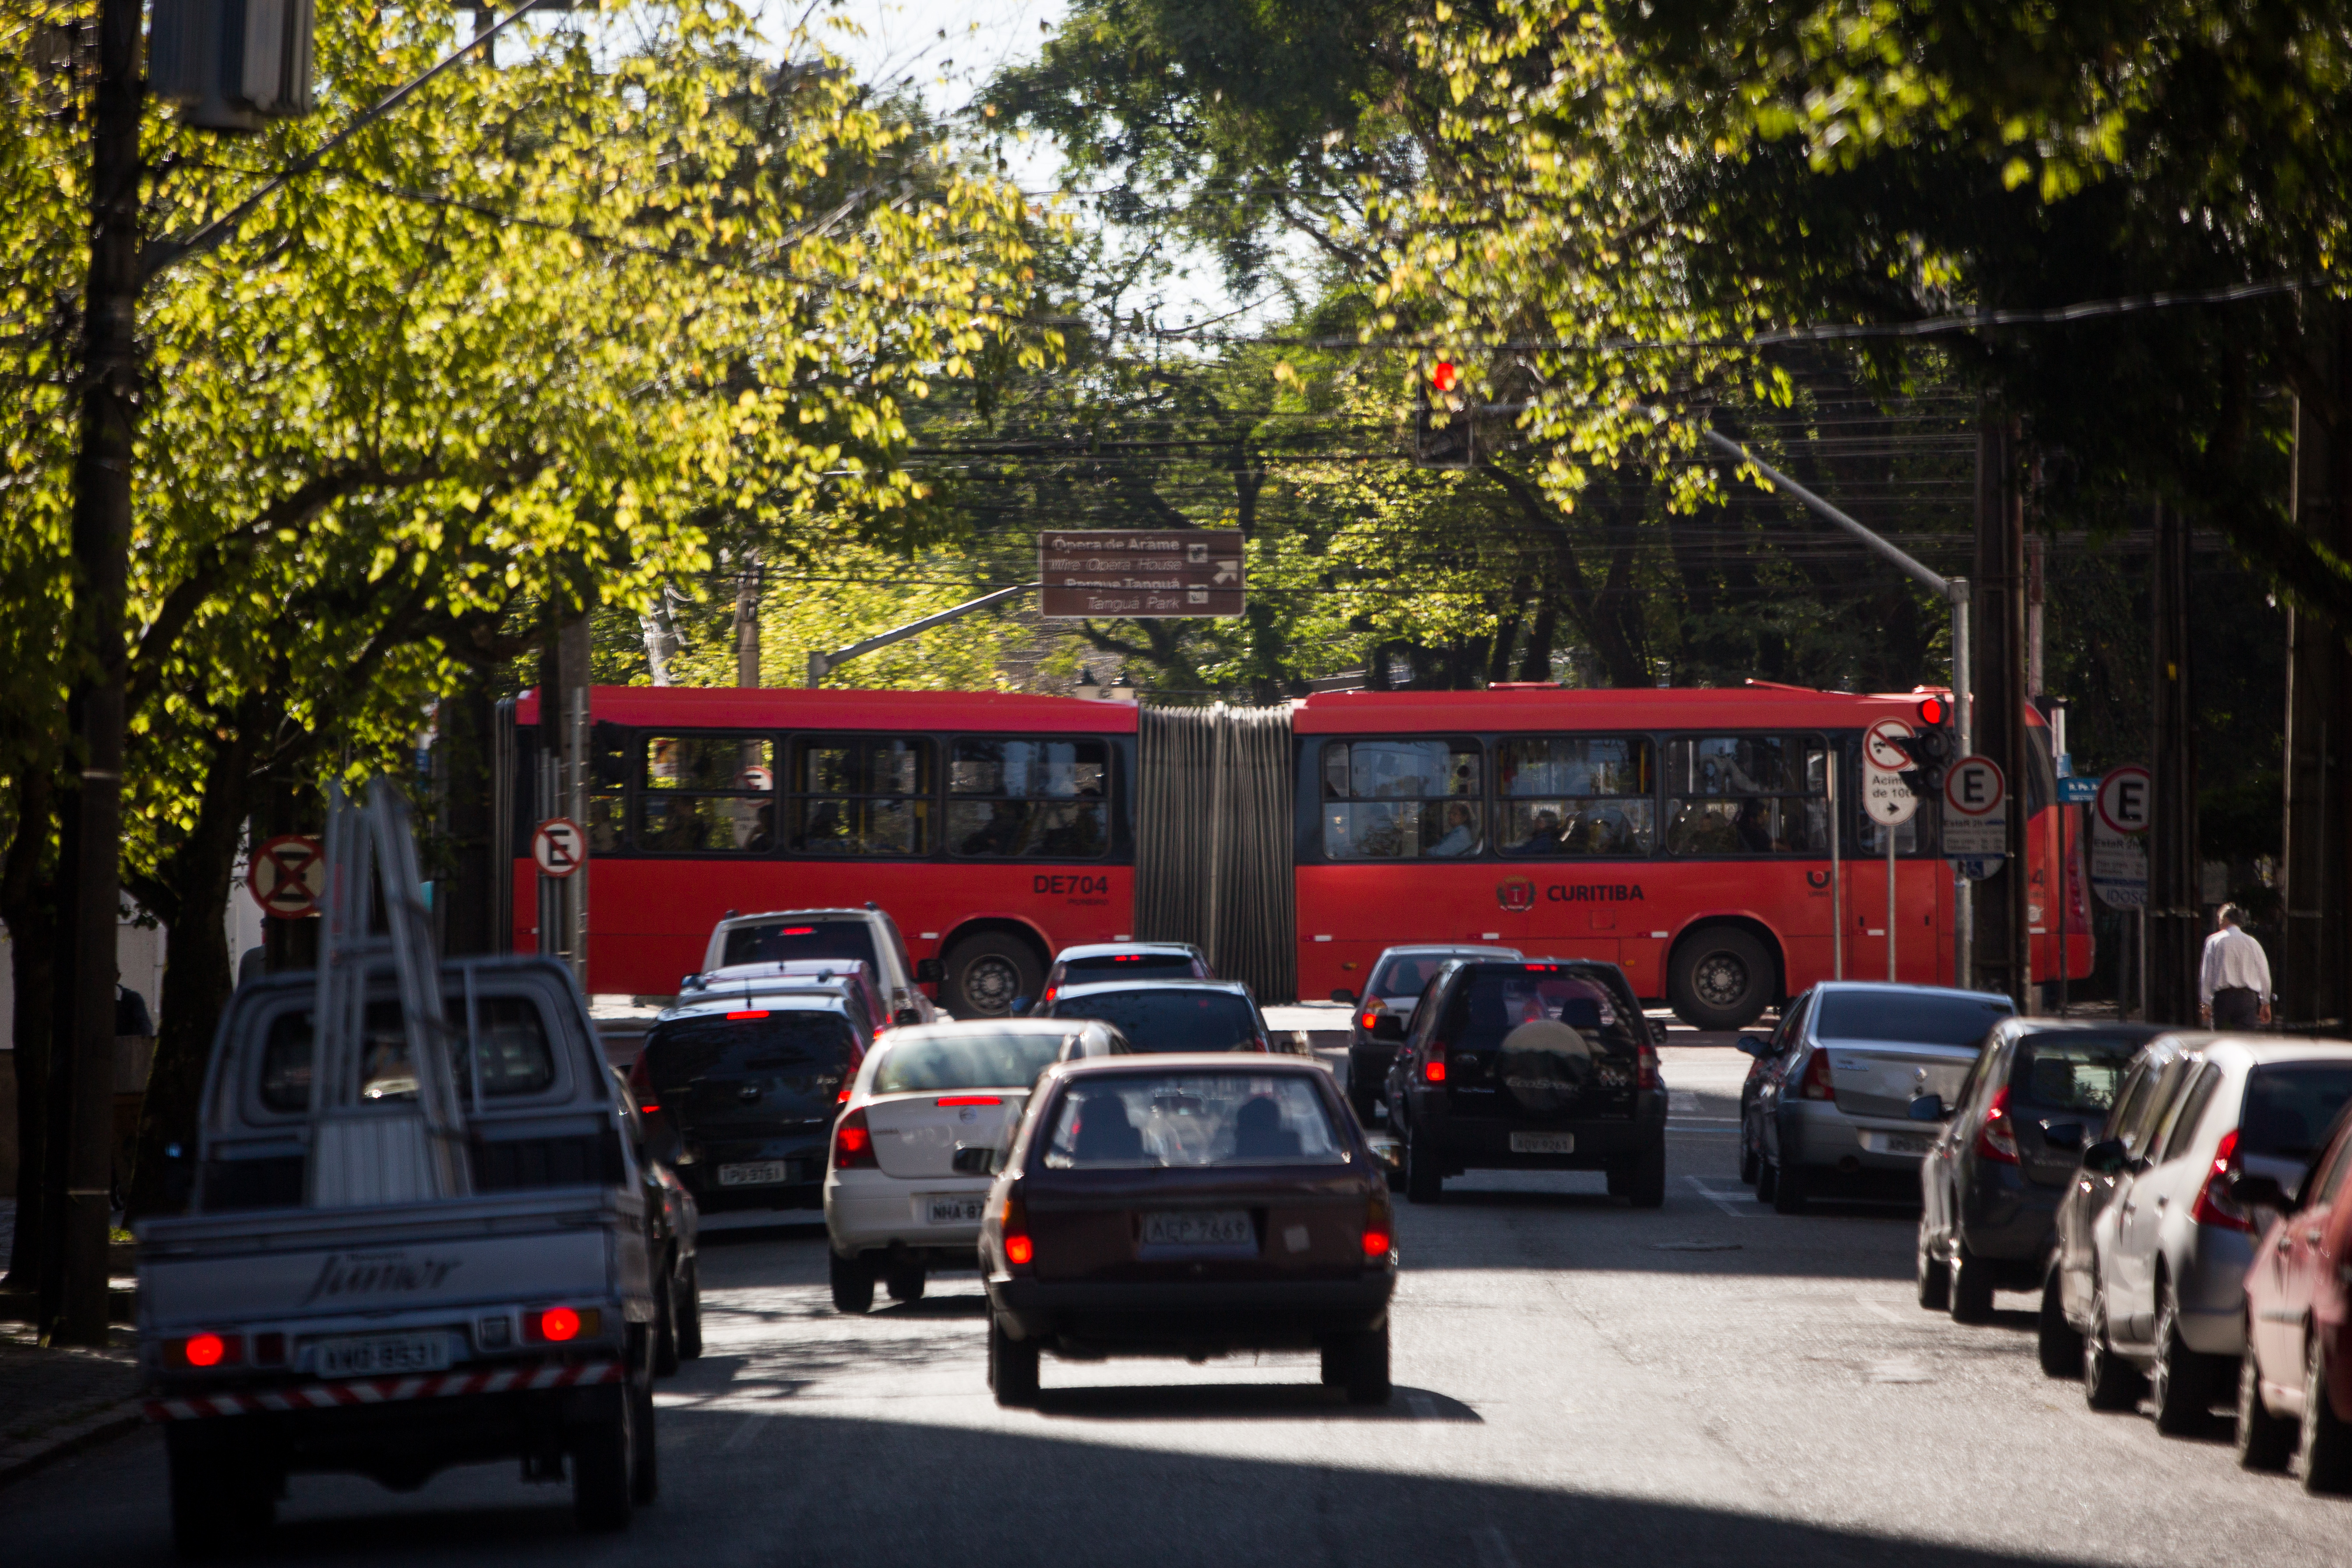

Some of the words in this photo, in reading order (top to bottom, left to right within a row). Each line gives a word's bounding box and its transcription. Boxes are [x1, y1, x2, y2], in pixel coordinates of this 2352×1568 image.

[1104, 539, 1125, 551] de
[1048, 559, 1081, 571] Wire
[1139, 559, 1182, 571] House
[1087, 595, 1140, 612] Tanguá
[1146, 596, 1179, 610] Park
[1872, 774, 1903, 785] Acim
[1964, 769, 1985, 803] E
[1872, 788, 1887, 798] de
[2118, 782, 2144, 821] E
[547, 829, 570, 866] E
[1034, 875, 1108, 894] DE704
[1547, 884, 1644, 902] CURITIBA
